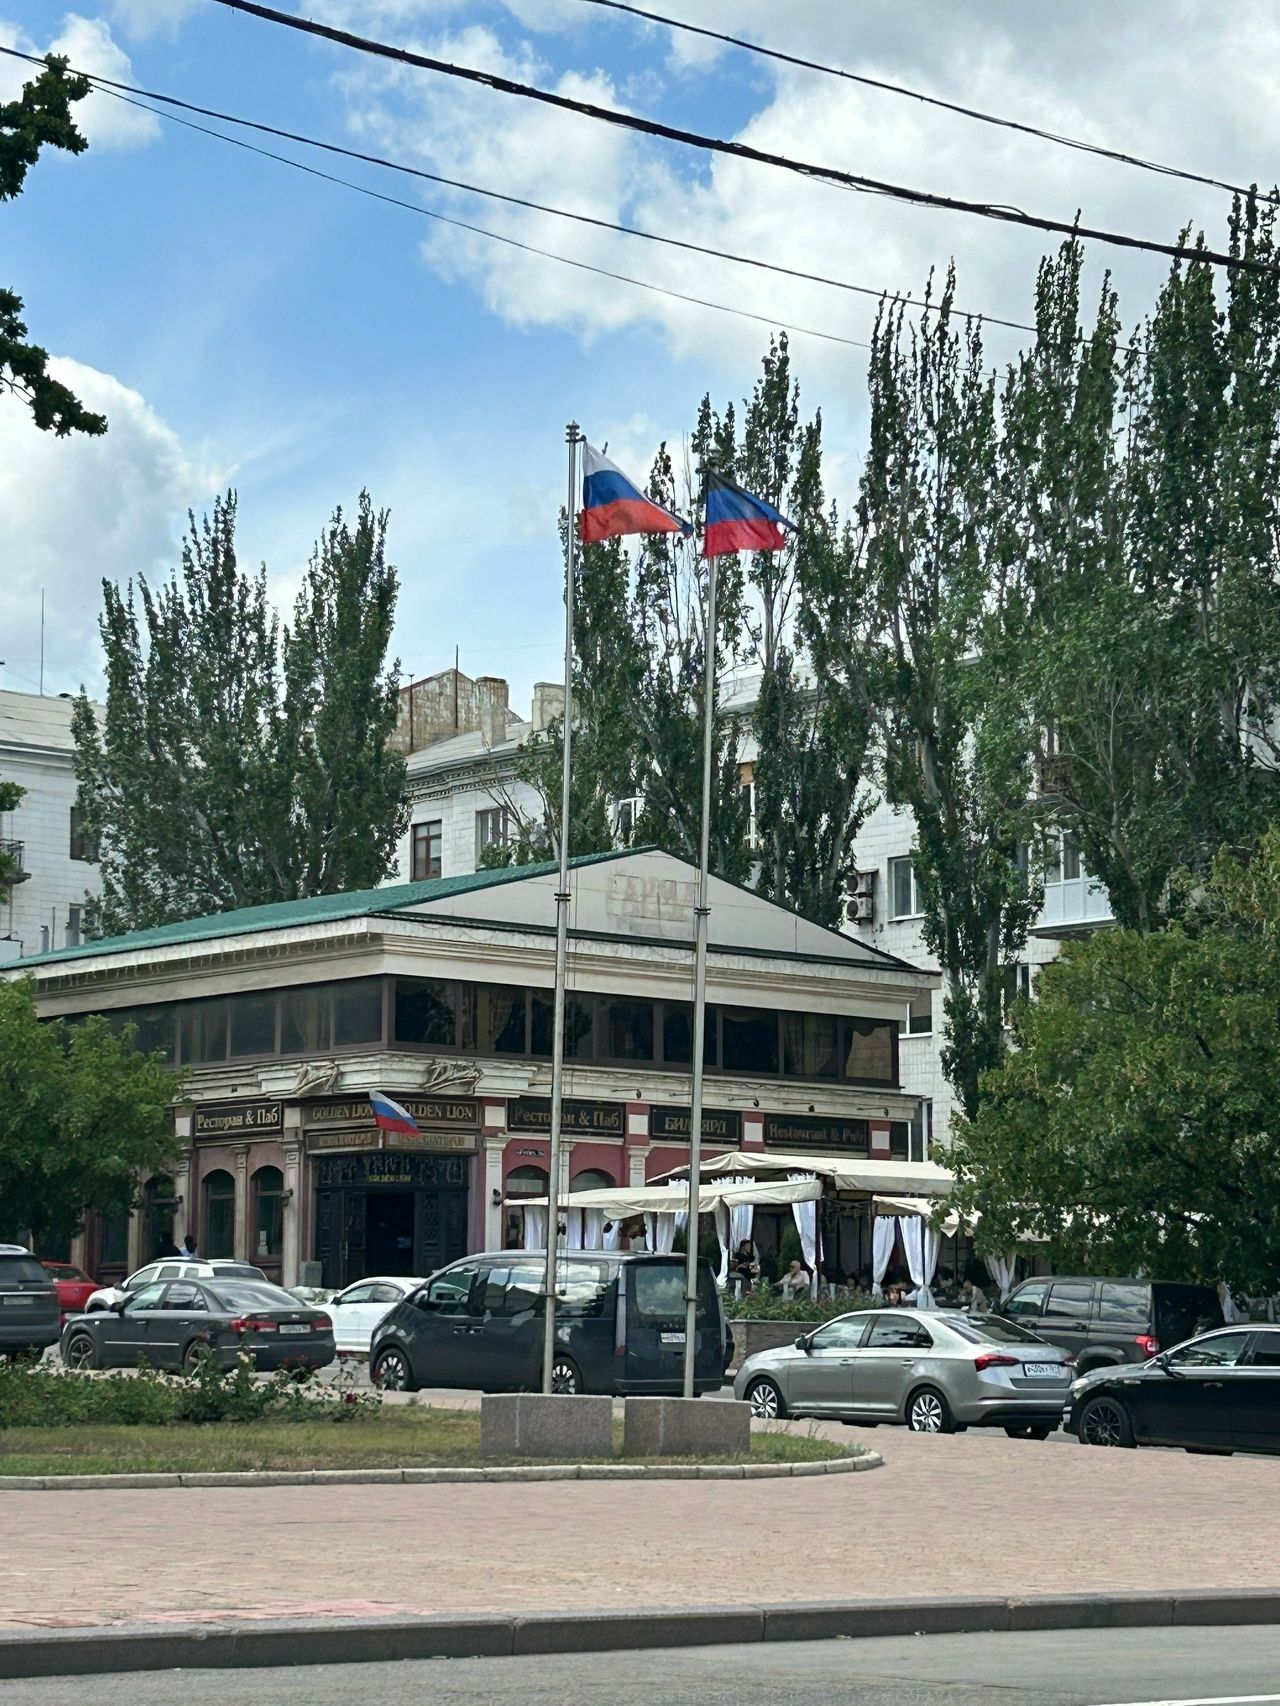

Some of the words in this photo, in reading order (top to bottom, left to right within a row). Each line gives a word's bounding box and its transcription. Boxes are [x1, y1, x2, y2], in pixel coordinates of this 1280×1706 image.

[245, 1109, 255, 1125] &
[257, 1106, 278, 1125] Паб
[312, 1104, 349, 1120] GOLDEN
[403, 1103, 442, 1118] OLDEN
[446, 1105, 473, 1120] LION
[513, 1111, 575, 1130] Рестоан
[578, 1114, 590, 1131] &
[593, 1115, 619, 1132] Паб
[665, 1116, 727, 1135] БИЛЯРД
